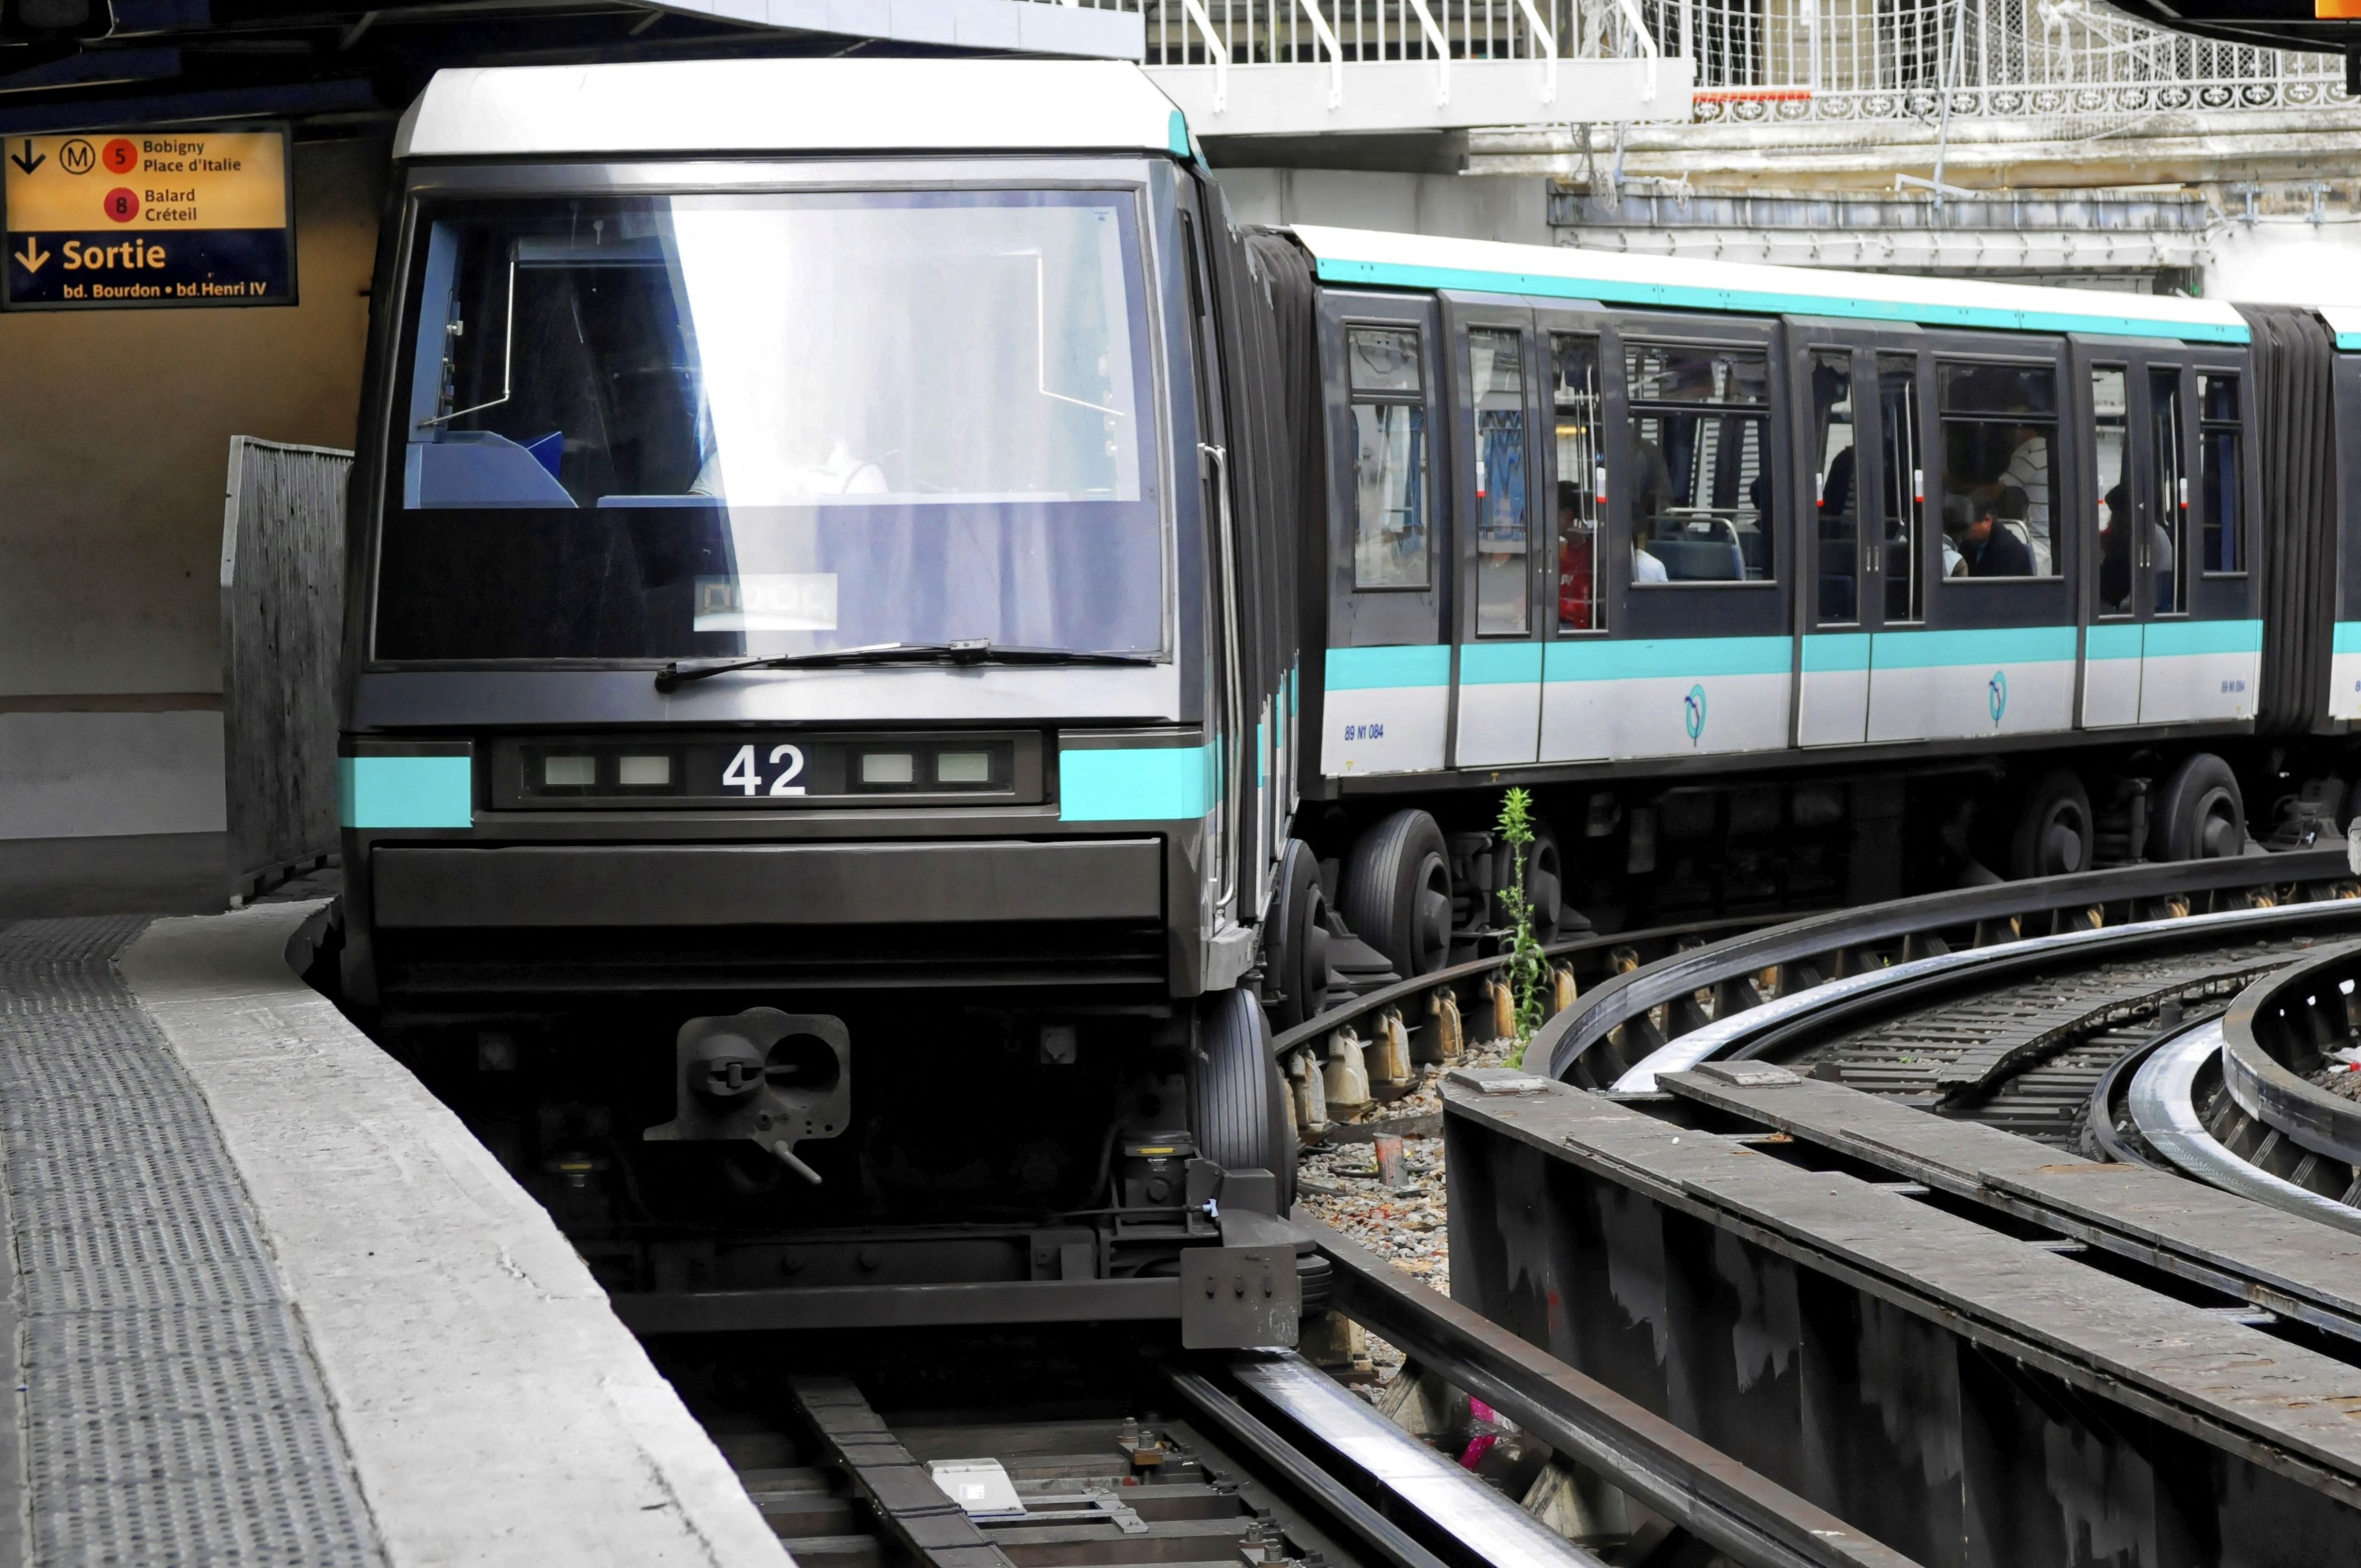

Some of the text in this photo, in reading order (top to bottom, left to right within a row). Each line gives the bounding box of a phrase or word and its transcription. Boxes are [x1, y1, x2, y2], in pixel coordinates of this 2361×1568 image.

[68, 140, 204, 166] M 5 Bobigny
[144, 158, 241, 172] Place d'Italie
[116, 188, 195, 214] 8 Balard
[145, 207, 197, 221] Créteil
[63, 238, 166, 270] Sortie
[63, 281, 266, 298] bd. Bourdon bd. Henri IV
[2355, 680, 2361, 692] 8
[1345, 725, 1355, 741] 89
[1369, 724, 1383, 739] 084
[722, 744, 806, 796] 42
